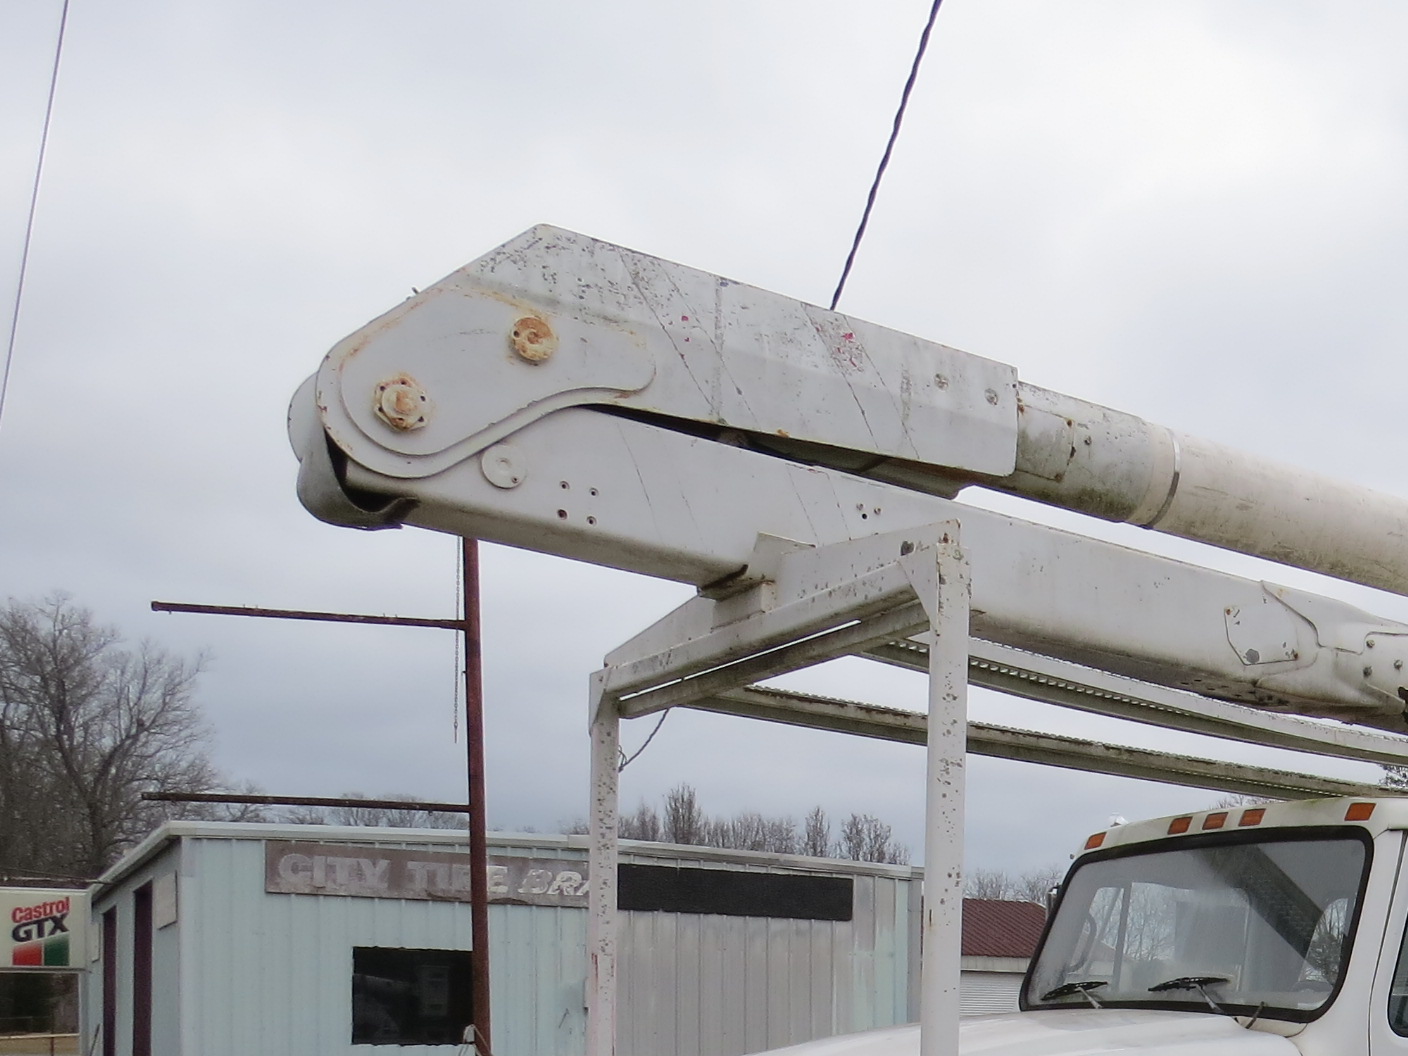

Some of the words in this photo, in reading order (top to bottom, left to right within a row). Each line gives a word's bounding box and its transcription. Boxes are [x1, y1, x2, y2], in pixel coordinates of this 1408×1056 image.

[279, 853, 391, 889] CITY
[12, 896, 70, 924] Castrol
[12, 913, 70, 942] GTX
